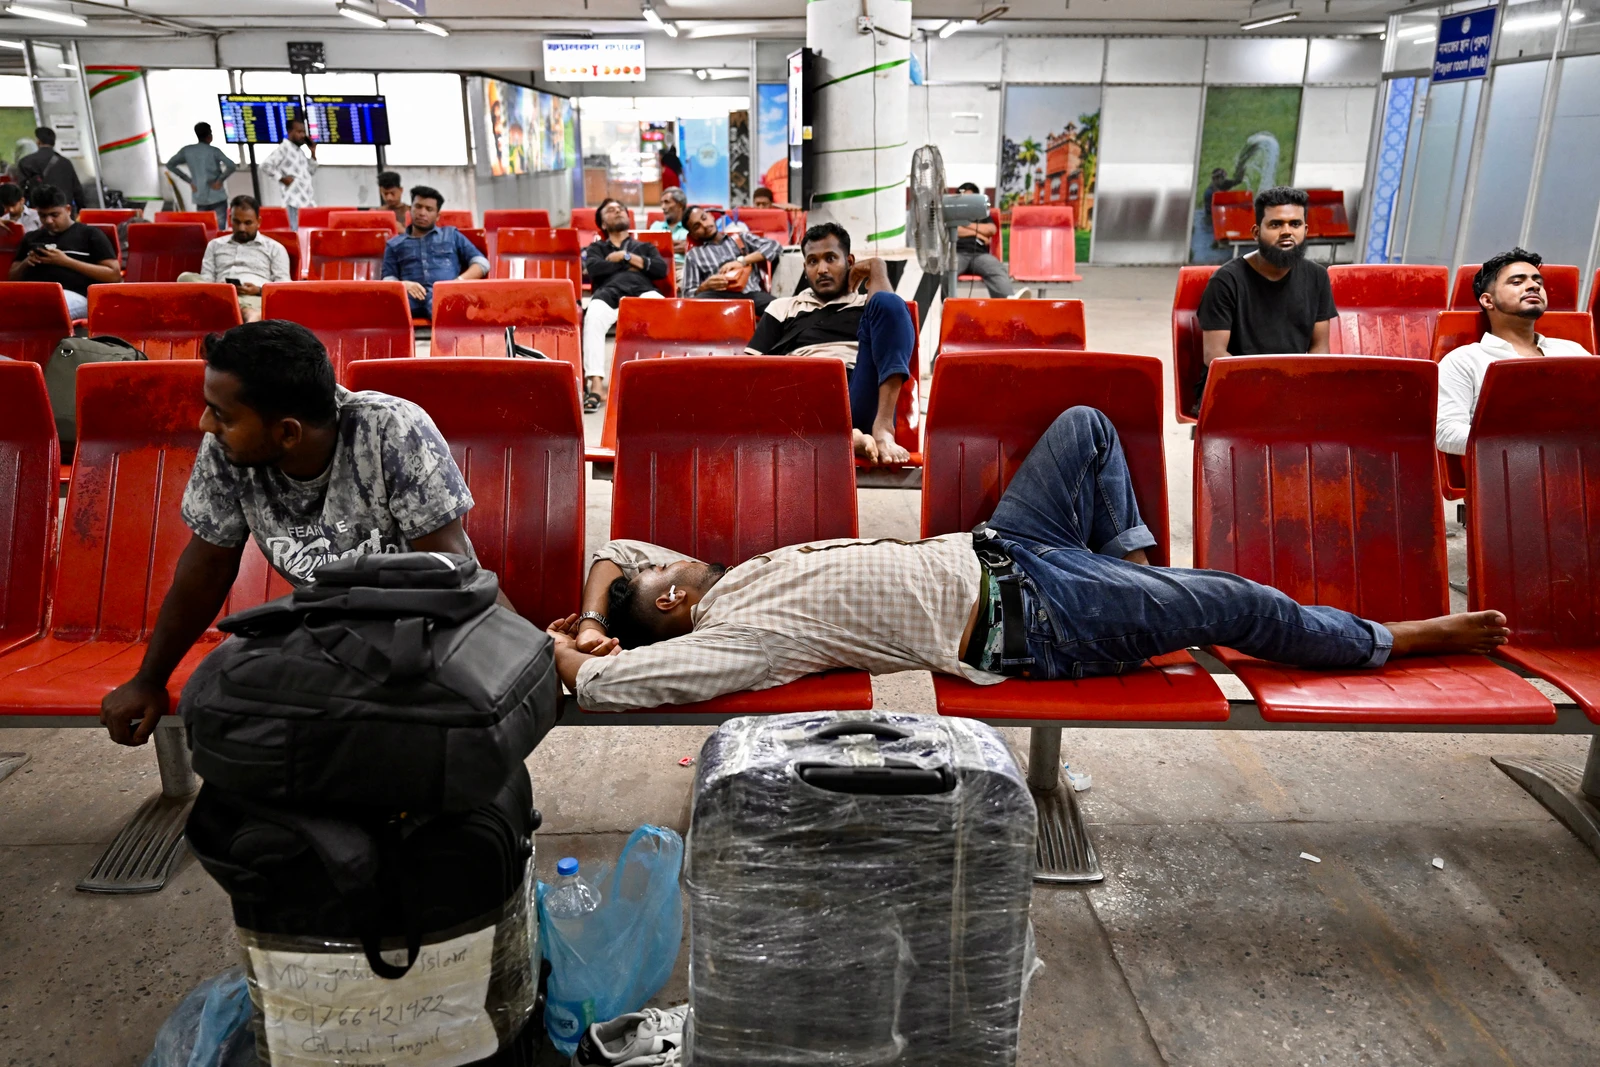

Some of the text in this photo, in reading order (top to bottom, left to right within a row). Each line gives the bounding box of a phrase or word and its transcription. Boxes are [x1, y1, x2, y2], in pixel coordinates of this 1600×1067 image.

[1434, 54, 1488, 76] Prayer room (Male)
